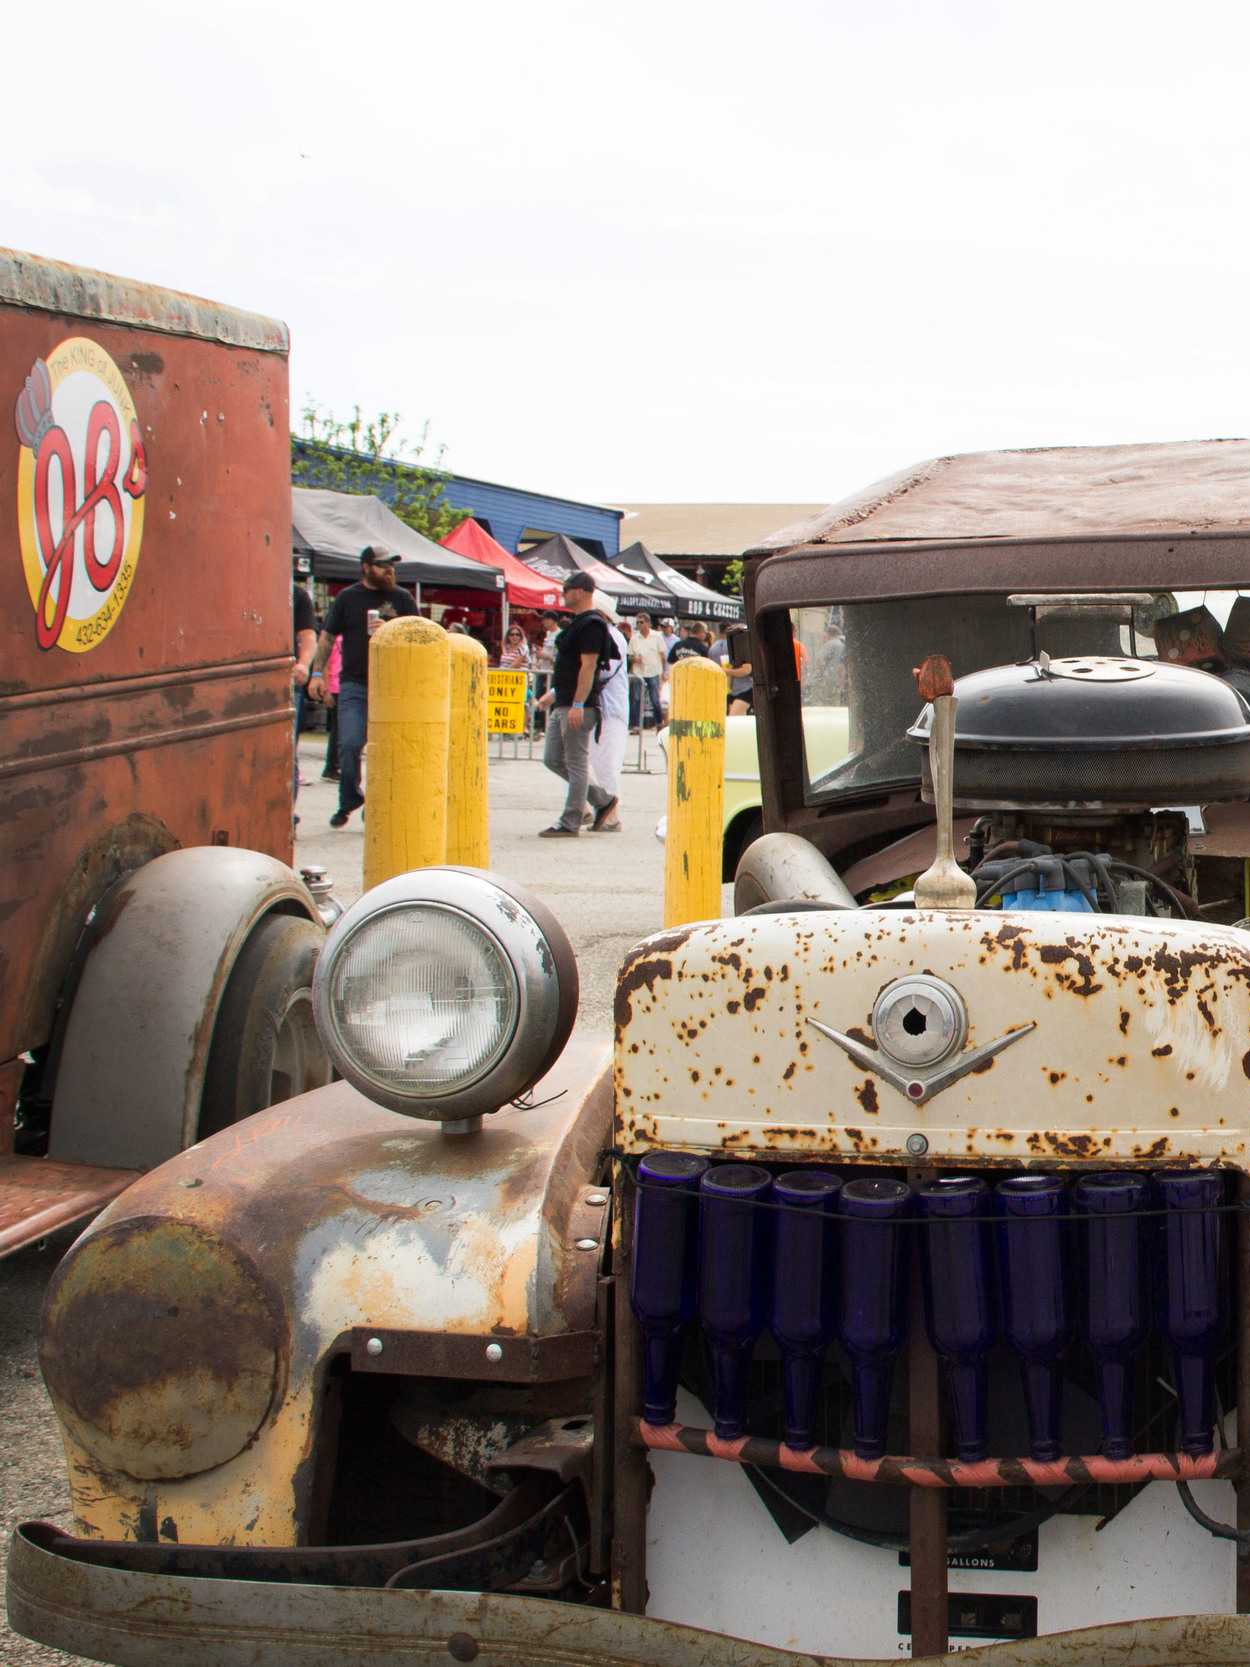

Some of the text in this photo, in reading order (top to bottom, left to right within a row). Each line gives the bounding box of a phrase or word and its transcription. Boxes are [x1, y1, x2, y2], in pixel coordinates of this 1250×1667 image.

[489, 686, 516, 697] ONLY
[494, 706, 509, 717] NO
[487, 719, 516, 730] CARS
